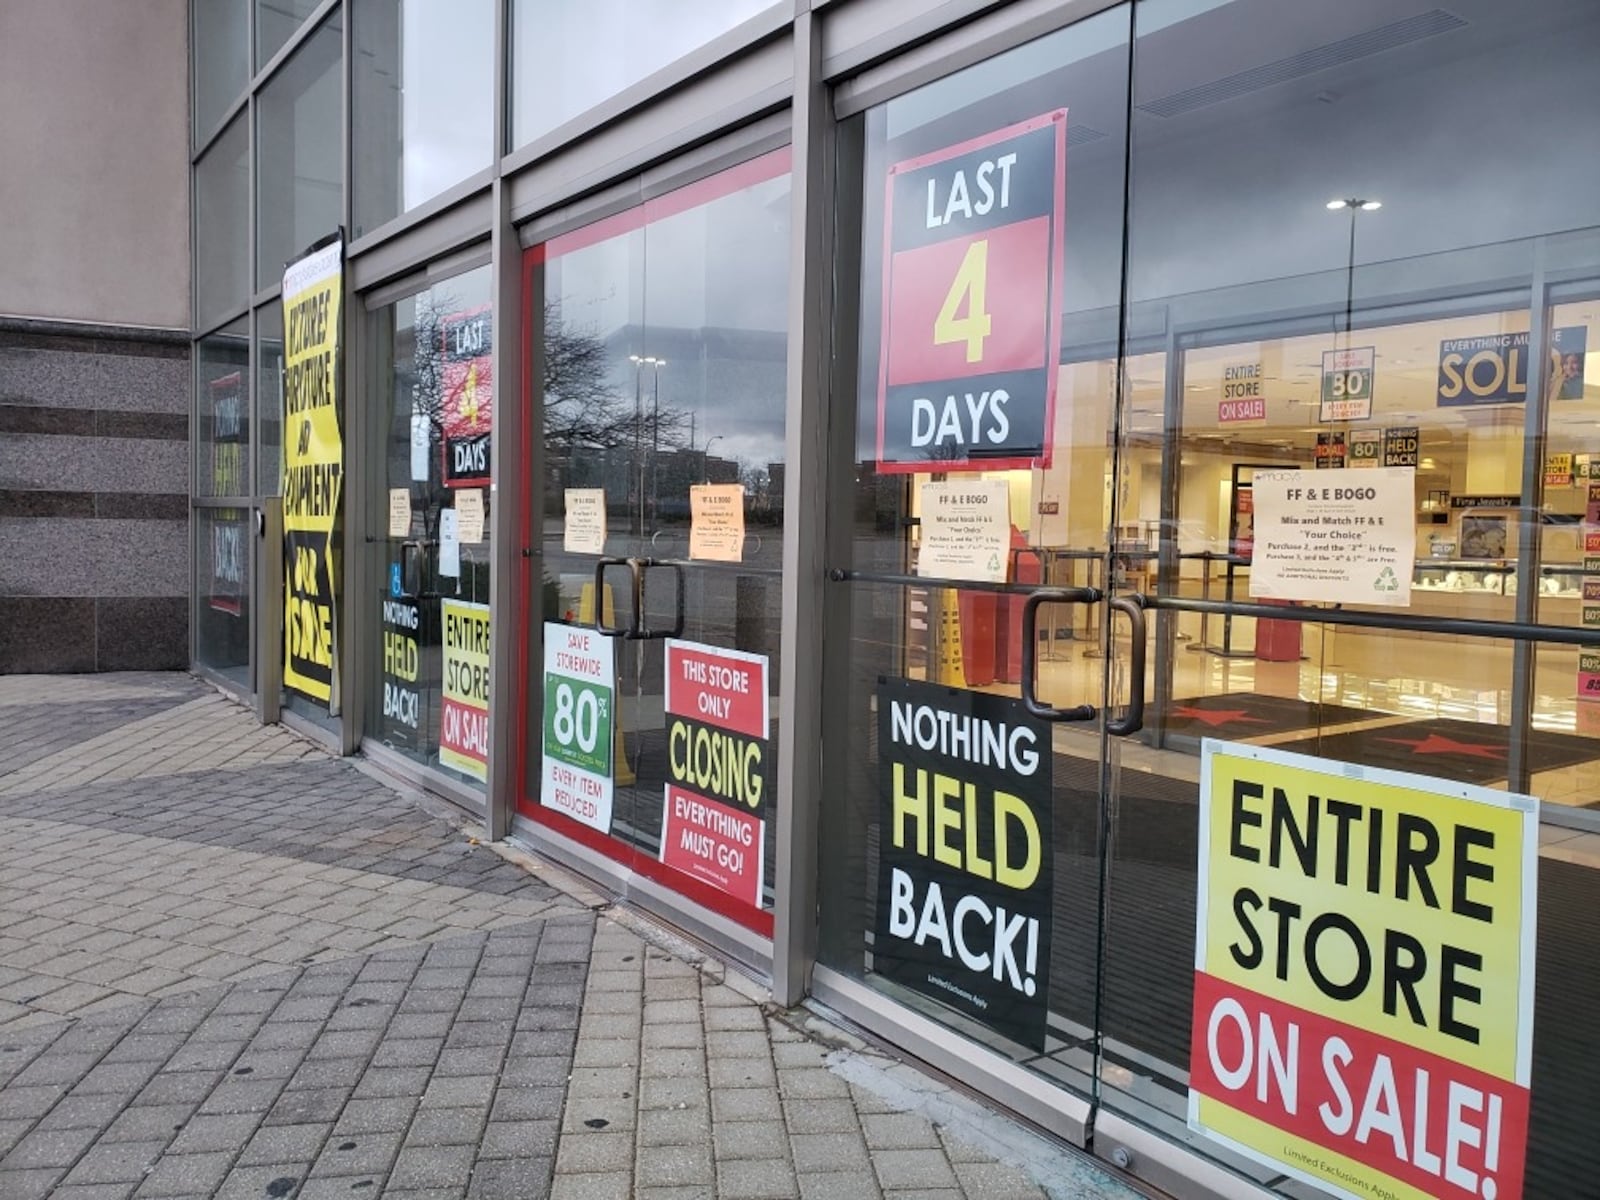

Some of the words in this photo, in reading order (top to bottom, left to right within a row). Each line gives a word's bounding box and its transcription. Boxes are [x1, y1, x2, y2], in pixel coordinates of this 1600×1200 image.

[926, 152, 1017, 229] LAST
[934, 239, 992, 363] 4
[456, 320, 484, 354] LAST
[1444, 336, 1511, 352] EVERYTHING
[1224, 382, 1260, 399] STORE
[1225, 364, 1261, 381] ENTIRE
[459, 363, 478, 428] 4
[1221, 403, 1236, 419] ON
[1237, 400, 1263, 417] SALE!
[911, 388, 1011, 448] DAYS
[455, 440, 486, 473] DAYS
[1318, 445, 1344, 457] TOAL
[1387, 439, 1417, 453] HELD
[966, 495, 988, 504] BOGO
[1287, 489, 1302, 501] FF
[1306, 488, 1317, 501] &
[1322, 488, 1330, 501] E
[1335, 487, 1376, 501] BOGO
[1281, 517, 1300, 525] Mix
[1301, 517, 1319, 525] and
[1322, 517, 1352, 525] Match
[1267, 542, 1302, 551] Purchase
[1313, 543, 1329, 551] and
[1331, 543, 1345, 551] the
[383, 601, 418, 630] NOTHING
[447, 614, 490, 656] ENTIRE
[567, 632, 590, 652] SAVE
[384, 631, 419, 683] HELD
[556, 652, 602, 678] STOREWIDE
[447, 659, 490, 701] STORE
[682, 659, 706, 685] THIS
[708, 664, 749, 694] STORE
[383, 682, 418, 729] BACK!
[444, 703, 461, 746] ON
[698, 692, 731, 720] ONLY
[890, 700, 1040, 777] NOTHING
[552, 765, 577, 791] EVERY
[580, 776, 602, 800] ITEM
[669, 720, 763, 809] CLOSING
[554, 788, 598, 821] REDUCED!
[674, 796, 753, 847] EVERYTHING
[892, 761, 1042, 891] HELD
[680, 828, 716, 860] MUST
[717, 843, 745, 876] GO!
[1230, 778, 1496, 924] ENTIRE
[888, 866, 1040, 998] BACK!
[1229, 886, 1483, 1046] STORE
[1207, 996, 1300, 1117] ON
[1318, 1035, 1503, 1200] SALE!
[1283, 1145, 1318, 1168] Limited
[1319, 1161, 1369, 1191] Exclusions
[1371, 1184, 1401, 1200] Appl
